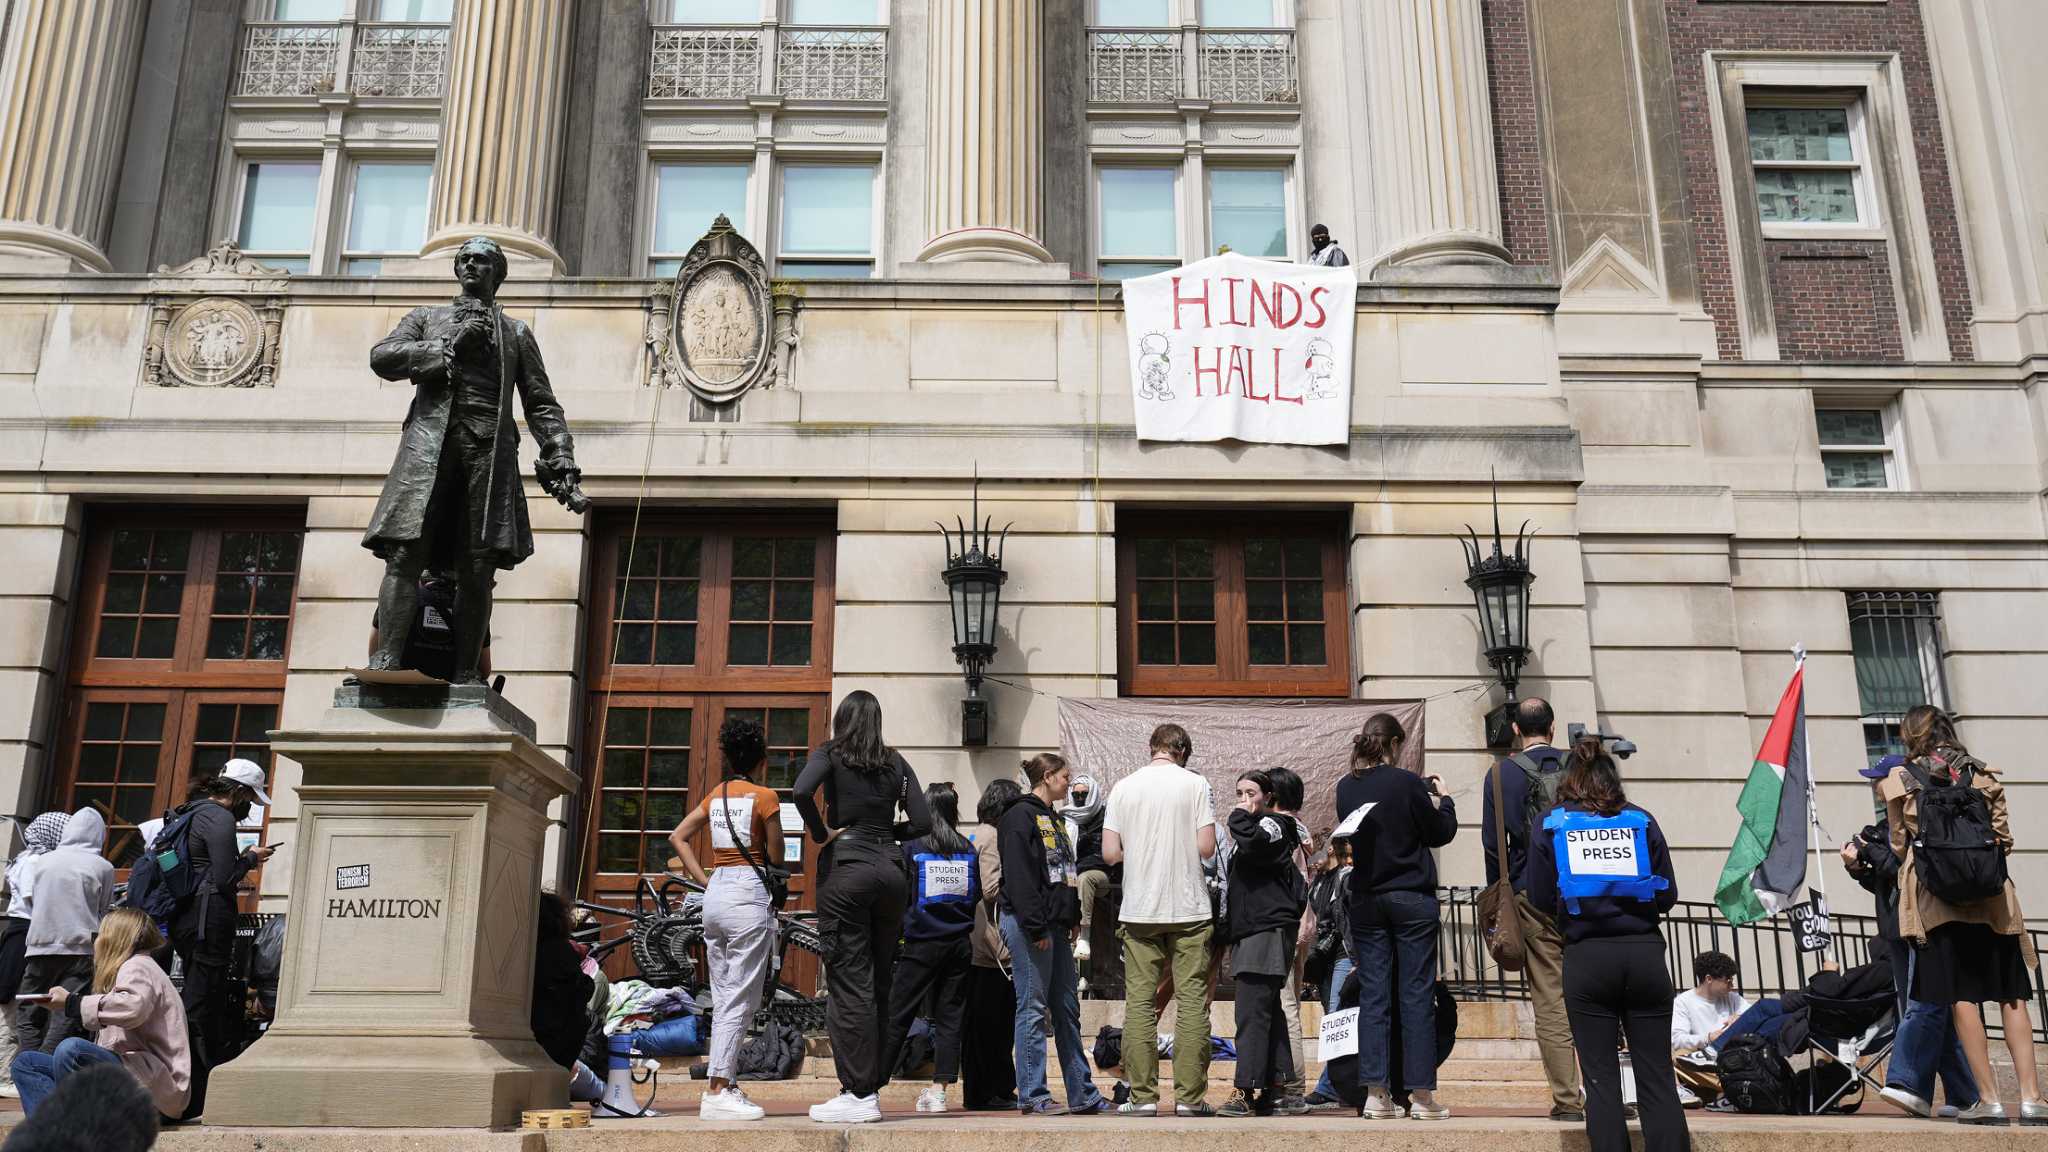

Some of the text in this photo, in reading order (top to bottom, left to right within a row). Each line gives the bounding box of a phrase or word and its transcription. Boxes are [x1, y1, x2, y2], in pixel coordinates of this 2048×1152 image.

[1192, 345, 1303, 405] HALL
[712, 809, 743, 817] STUENT
[1567, 828, 1640, 842] STUDENT
[1583, 847, 1632, 860] PRESS
[362, 865, 369, 876] IS
[929, 866, 965, 874] STUDENT
[935, 877, 960, 885] PRESS
[327, 899, 441, 918] HAMILTON
[1322, 1014, 1357, 1032] STUDENT
[1326, 1030, 1349, 1044] PRESS
